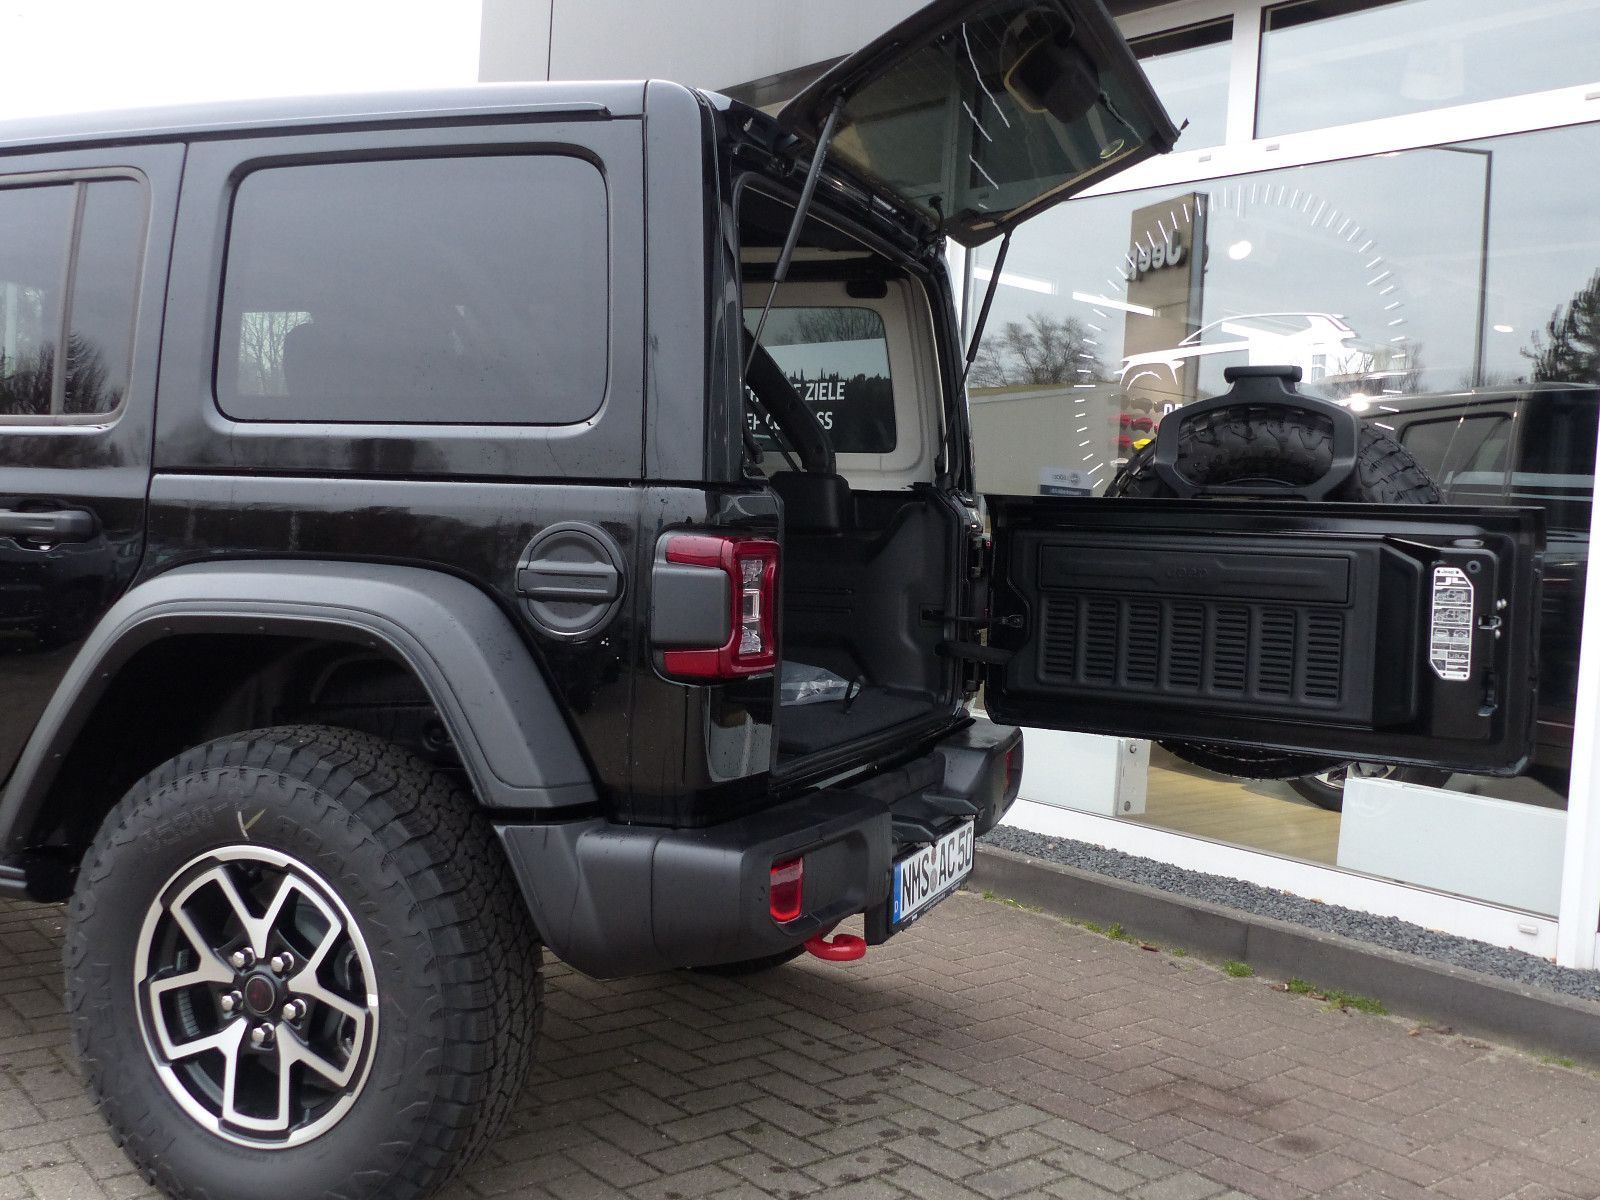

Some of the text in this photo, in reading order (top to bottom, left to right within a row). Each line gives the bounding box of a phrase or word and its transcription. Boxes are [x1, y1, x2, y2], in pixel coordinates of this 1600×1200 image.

[805, 382, 846, 401] ZIELE
[902, 853, 930, 911] NMS
[939, 837, 955, 886] AC
[958, 826, 973, 871] 50
